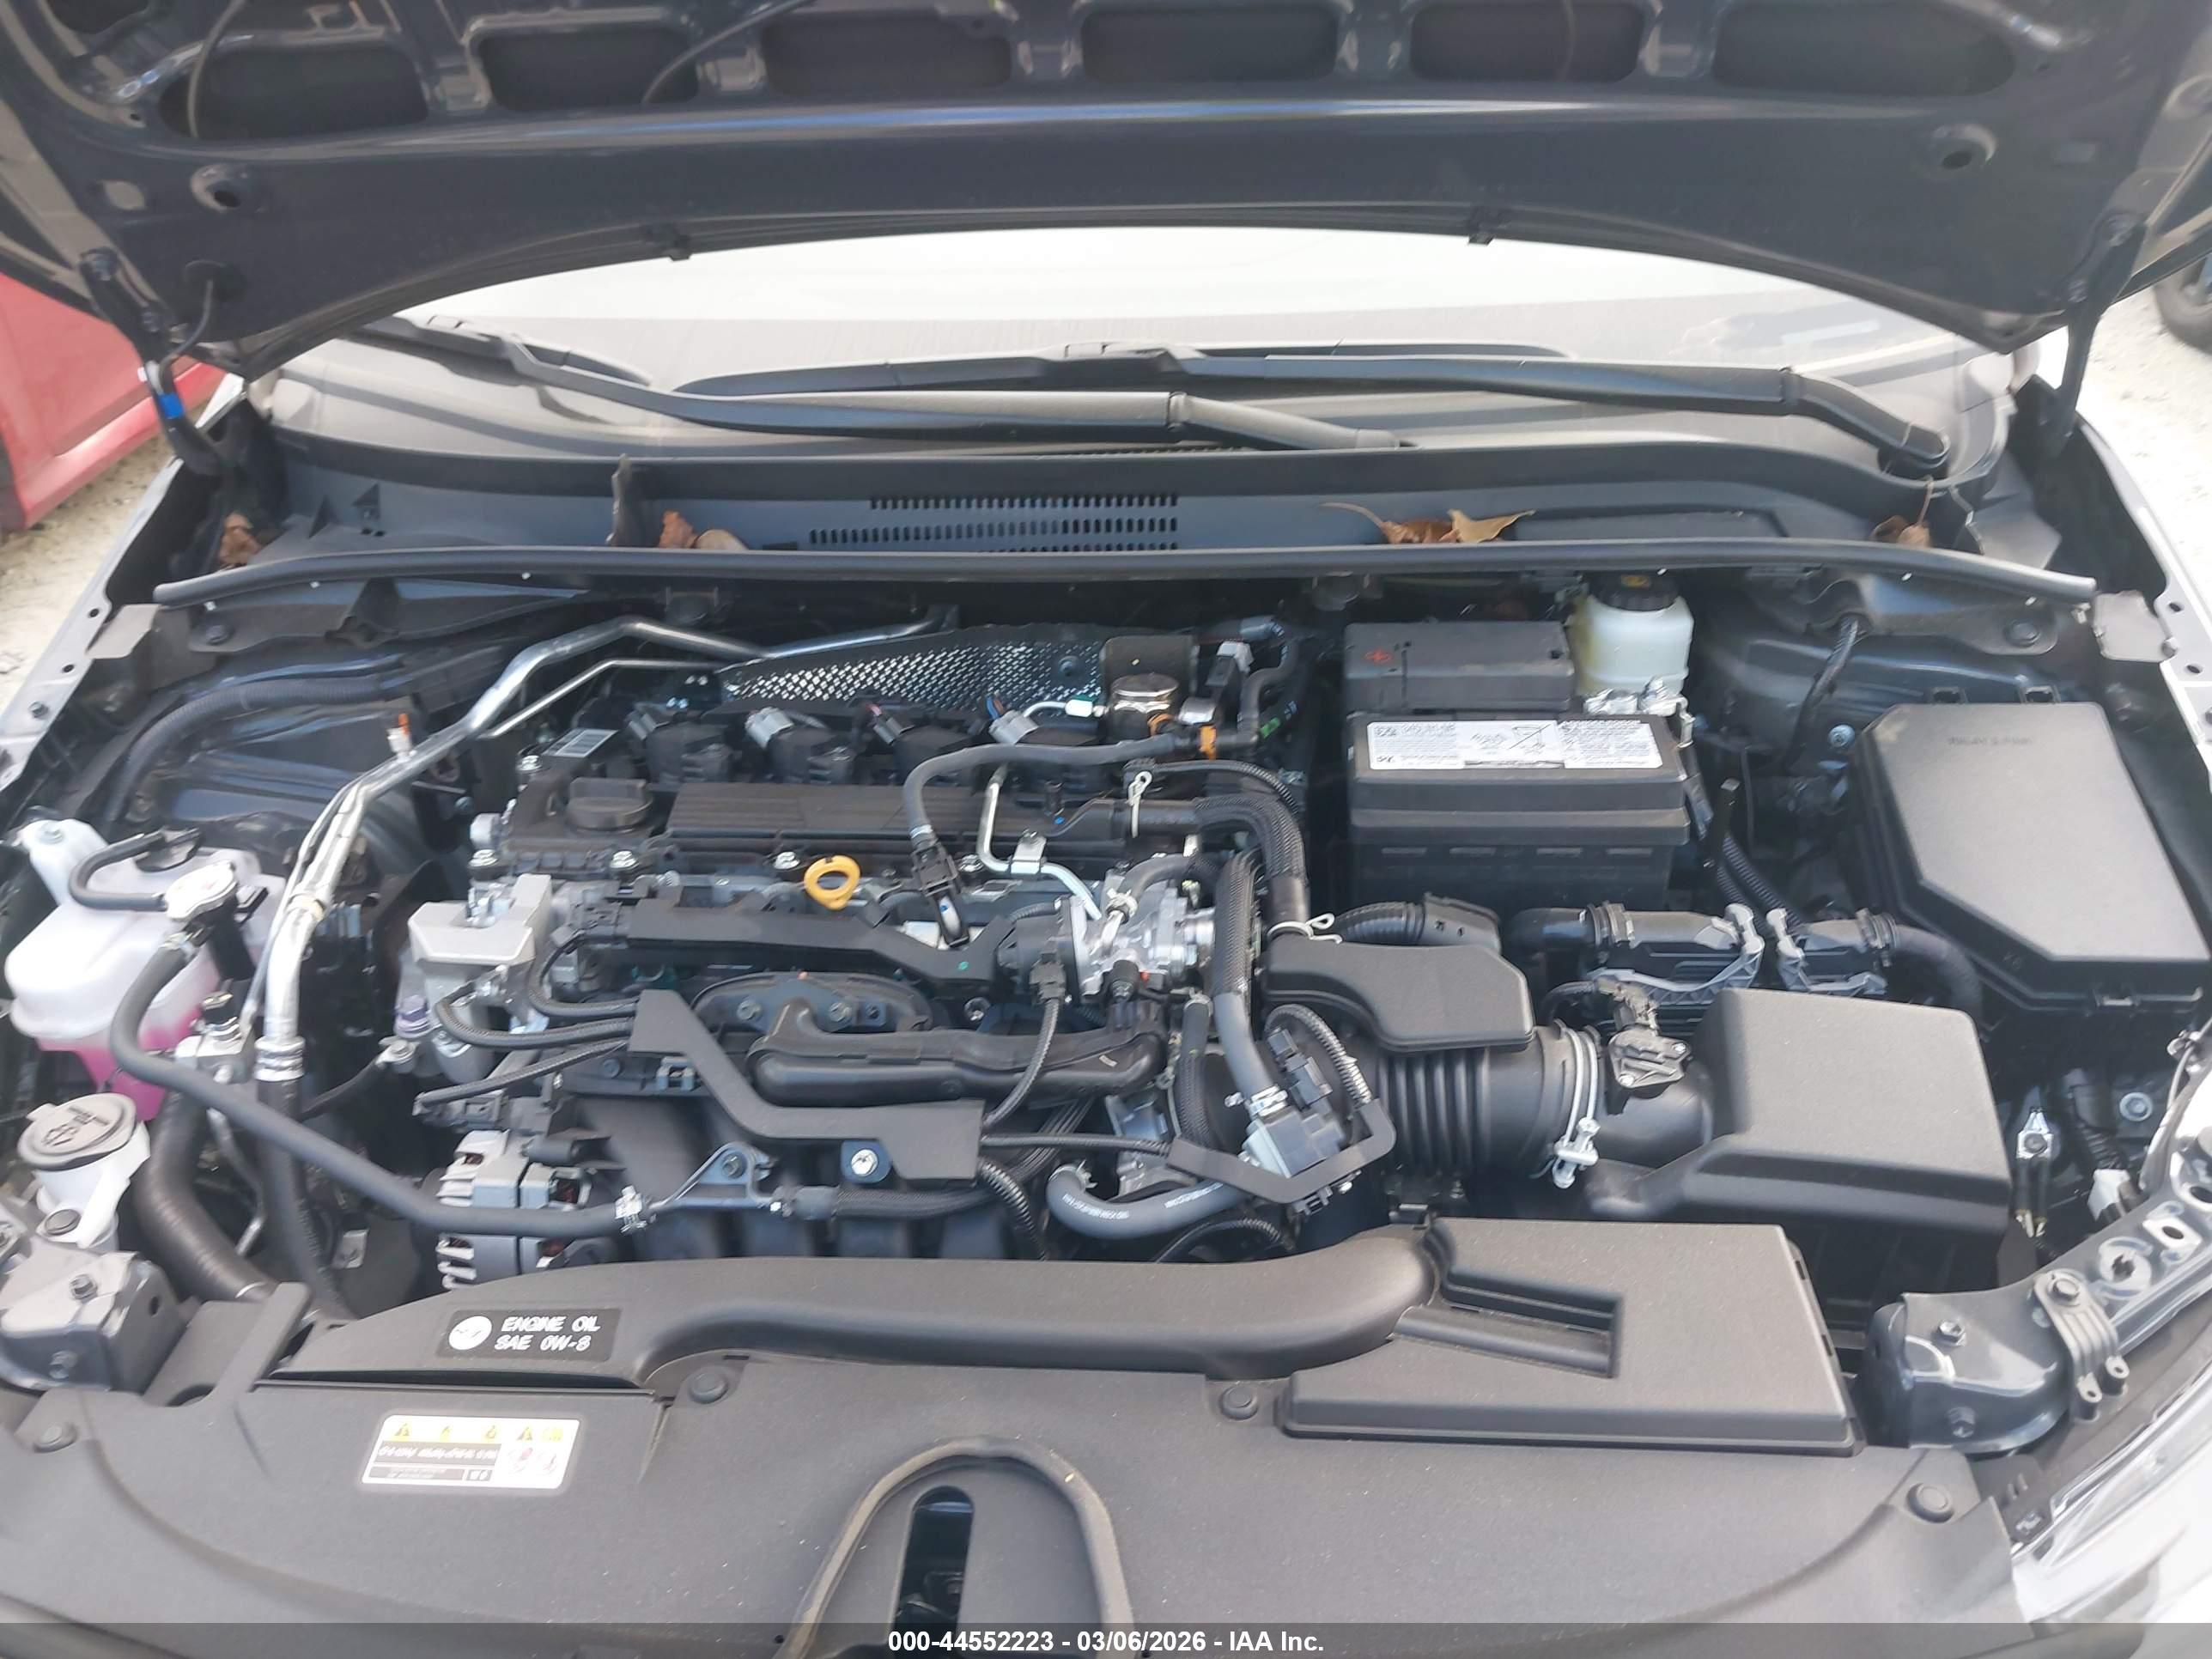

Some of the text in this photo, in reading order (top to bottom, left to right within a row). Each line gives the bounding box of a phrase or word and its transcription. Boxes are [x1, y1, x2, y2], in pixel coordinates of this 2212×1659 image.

[501, 1316, 601, 1332] ENGINE OIL
[494, 1334, 592, 1352] SAE 0W-8
